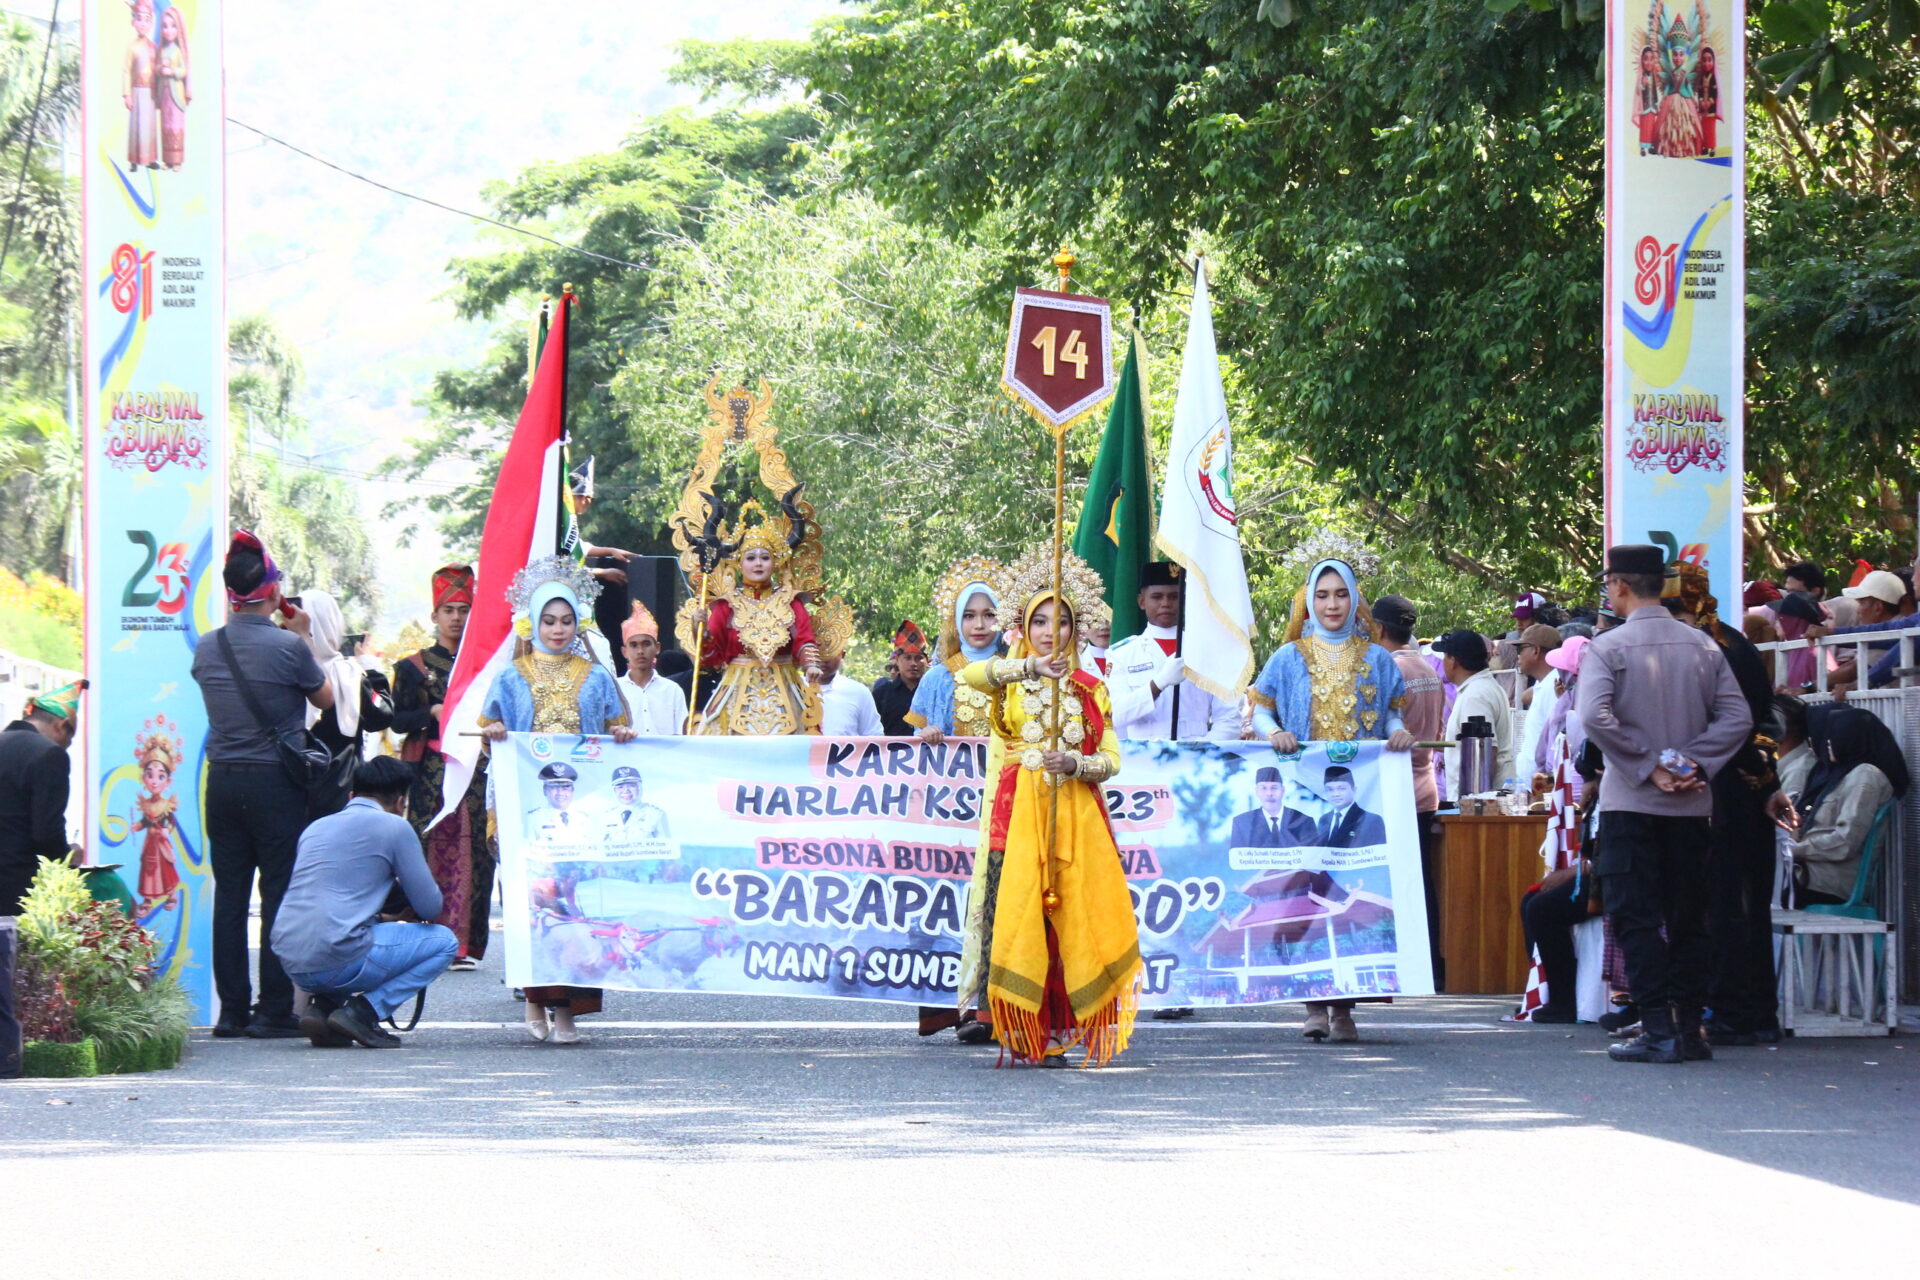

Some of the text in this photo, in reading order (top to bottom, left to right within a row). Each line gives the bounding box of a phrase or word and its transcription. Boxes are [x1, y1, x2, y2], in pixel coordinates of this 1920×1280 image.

[162, 257, 202, 267] INDONESIA
[1684, 250, 1722, 260] INDONESIA
[1684, 263, 1725, 273] BERDAULAT
[111, 243, 157, 322] 81
[162, 271, 204, 281] BERDAULAT
[162, 285, 195, 294] ADIL DAN
[1634, 235, 1680, 315] 81
[1684, 277, 1717, 286] ADIL DAN
[162, 298, 196, 308] MAKMUR
[1684, 290, 1717, 300] MAKMUR
[1031, 325, 1089, 379] 14
[111, 391, 204, 421] KARNAVAL
[1633, 393, 1725, 423] KARNAVAL
[111, 418, 200, 472] BUDAYA
[1633, 420, 1720, 474] BUDAYA
[735, 784, 909, 816] HARLAH
[924, 784, 984, 821] KS
[760, 841, 887, 869] PESONA
[893, 845, 976, 876] BUDA
[748, 945, 827, 979] MAN
[839, 950, 856, 980] 1
